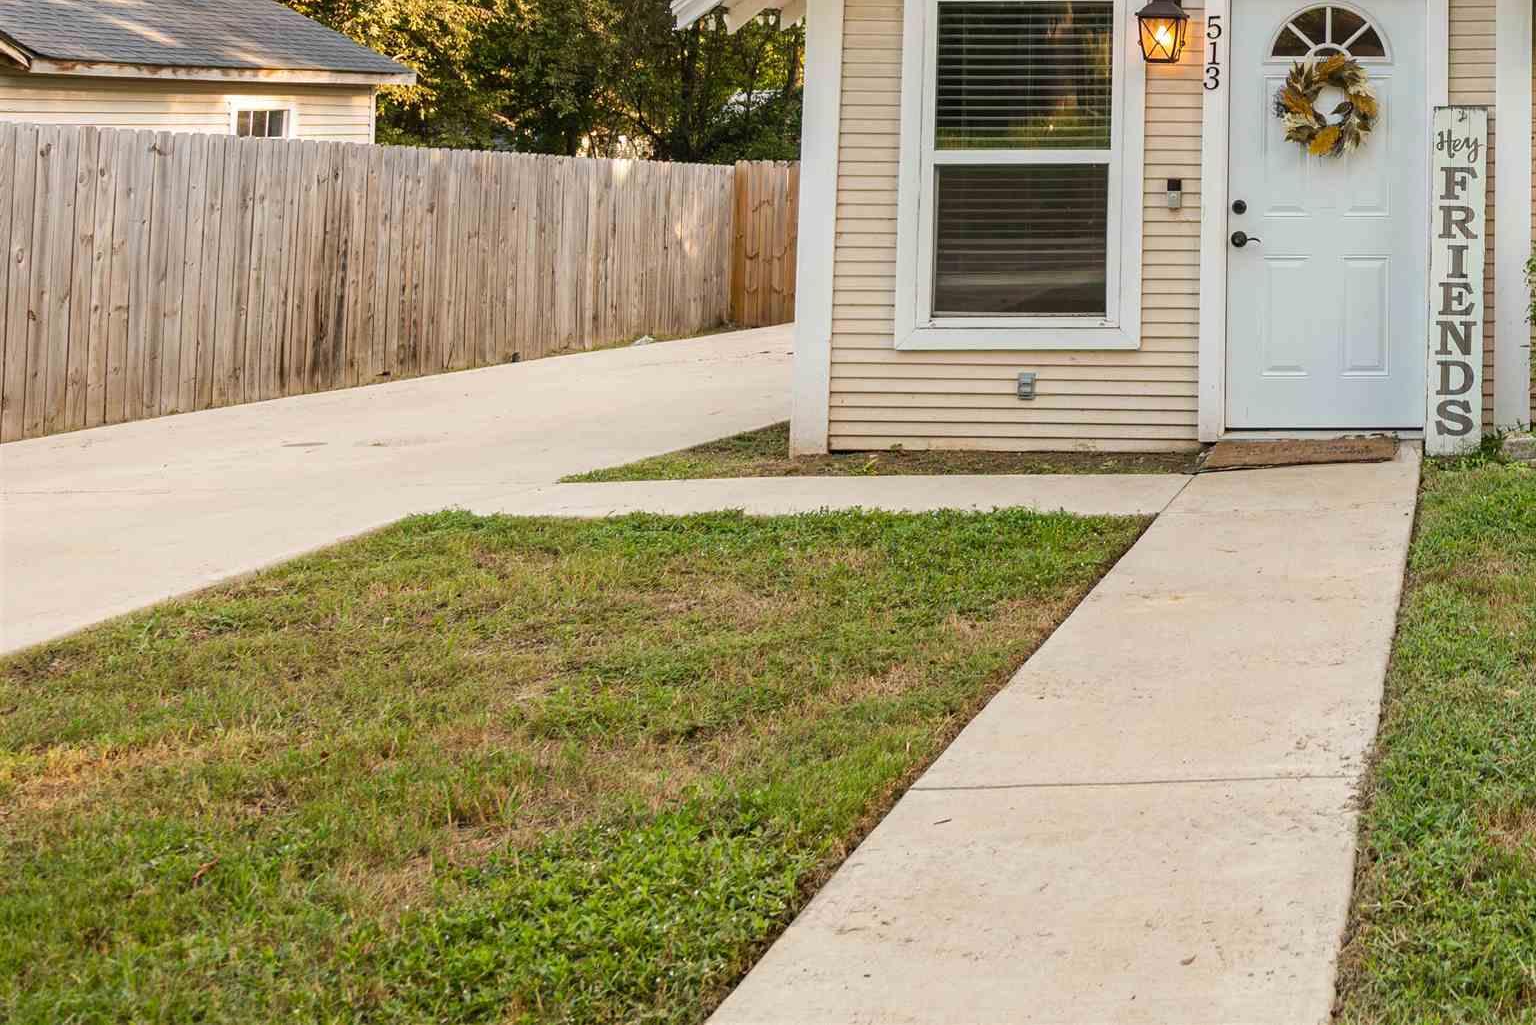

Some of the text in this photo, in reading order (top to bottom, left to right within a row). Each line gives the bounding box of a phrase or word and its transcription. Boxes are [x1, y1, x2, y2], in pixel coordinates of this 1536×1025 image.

[1203, 15, 1222, 90] 513
[1436, 128, 1485, 163] Hey
[1434, 166, 1478, 437] FRIENDS
